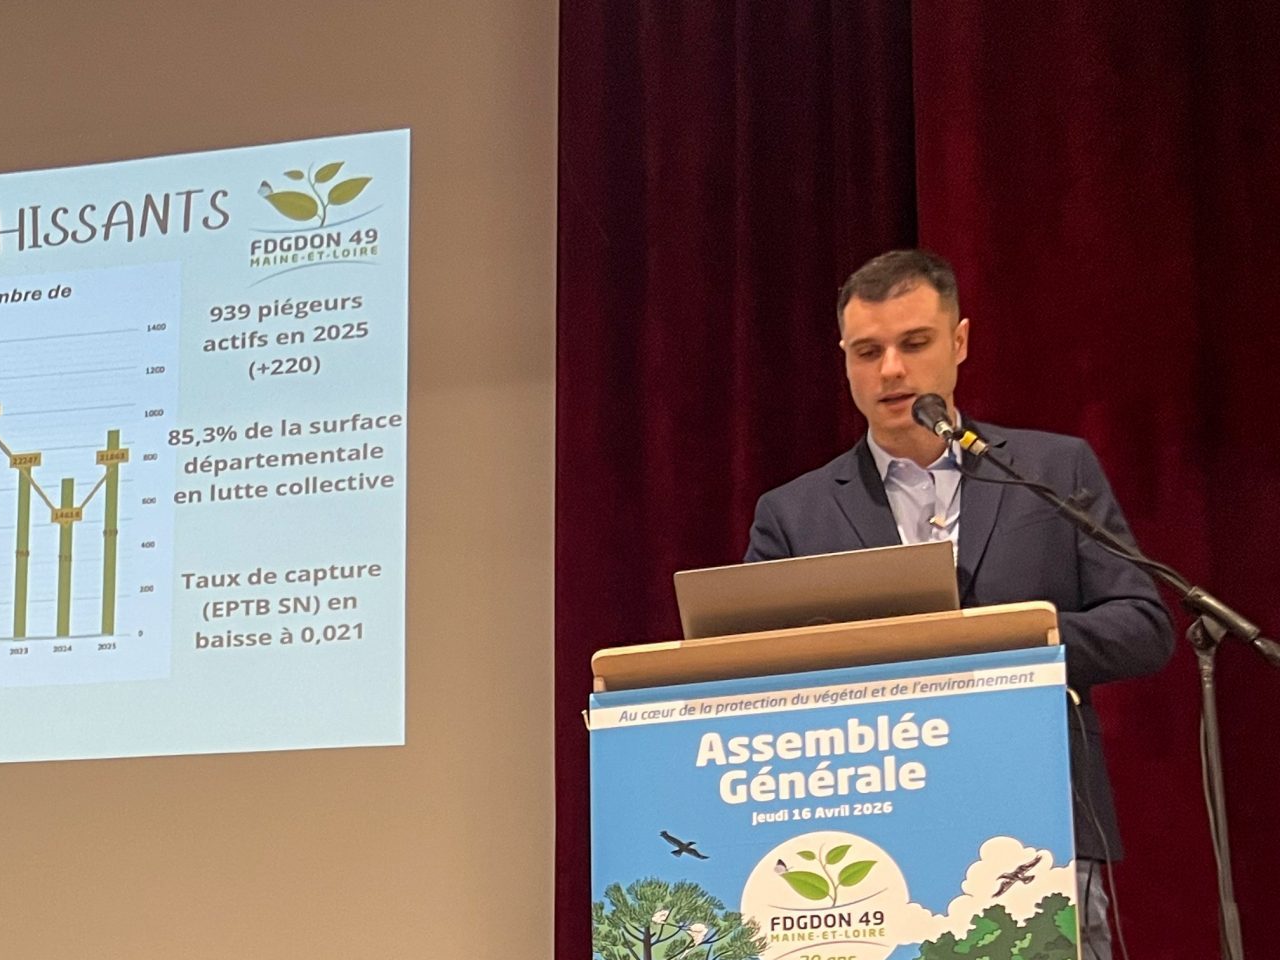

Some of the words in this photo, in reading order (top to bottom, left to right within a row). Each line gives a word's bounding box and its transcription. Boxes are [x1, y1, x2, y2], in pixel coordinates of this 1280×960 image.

[249, 231, 341, 257] FDGDON
[348, 228, 378, 246] 49
[249, 245, 379, 269] MAINE-ET-LOIRE
[47, 284, 72, 300] de
[210, 303, 251, 323] 939
[258, 294, 364, 322] piégeurs
[147, 322, 167, 333] 1400
[202, 330, 268, 353] actifs
[276, 331, 305, 345] en
[312, 321, 369, 343] 2025
[145, 366, 166, 375] 1200
[248, 355, 321, 381] (+220)
[167, 425, 238, 447] 85,3%
[244, 421, 273, 440] de
[281, 419, 302, 437] la
[309, 413, 402, 435] surface
[183, 443, 384, 477] départementale
[173, 490, 202, 504] en
[210, 483, 268, 502] lutte
[275, 472, 395, 497] collective
[181, 573, 241, 590] Taux
[247, 567, 278, 586] de
[284, 564, 382, 587] capture
[202, 599, 271, 622] (EPTB
[277, 595, 321, 616] SN)
[327, 596, 357, 611] en
[195, 629, 272, 649] baisse
[279, 626, 293, 645] à
[300, 622, 363, 645] 0,021
[618, 710, 638, 723] Au
[640, 707, 677, 721] cœur
[679, 703, 697, 717] de
[699, 702, 713, 714] la
[715, 696, 788, 715] protection
[791, 693, 810, 706] du
[812, 686, 868, 705] végétal
[871, 686, 887, 698] et
[889, 683, 909, 696] de
[912, 671, 1035, 694] l'environnement
[695, 712, 950, 767] Assemblée
[720, 756, 926, 804] Générale
[751, 809, 789, 826] Jeudi
[792, 807, 812, 820] 16
[814, 804, 850, 819] Avril
[853, 801, 893, 816] 2026
[770, 912, 852, 932] FDGDON
[858, 910, 884, 927] 49
[770, 927, 885, 943] MAINE-ET-LOIRE
